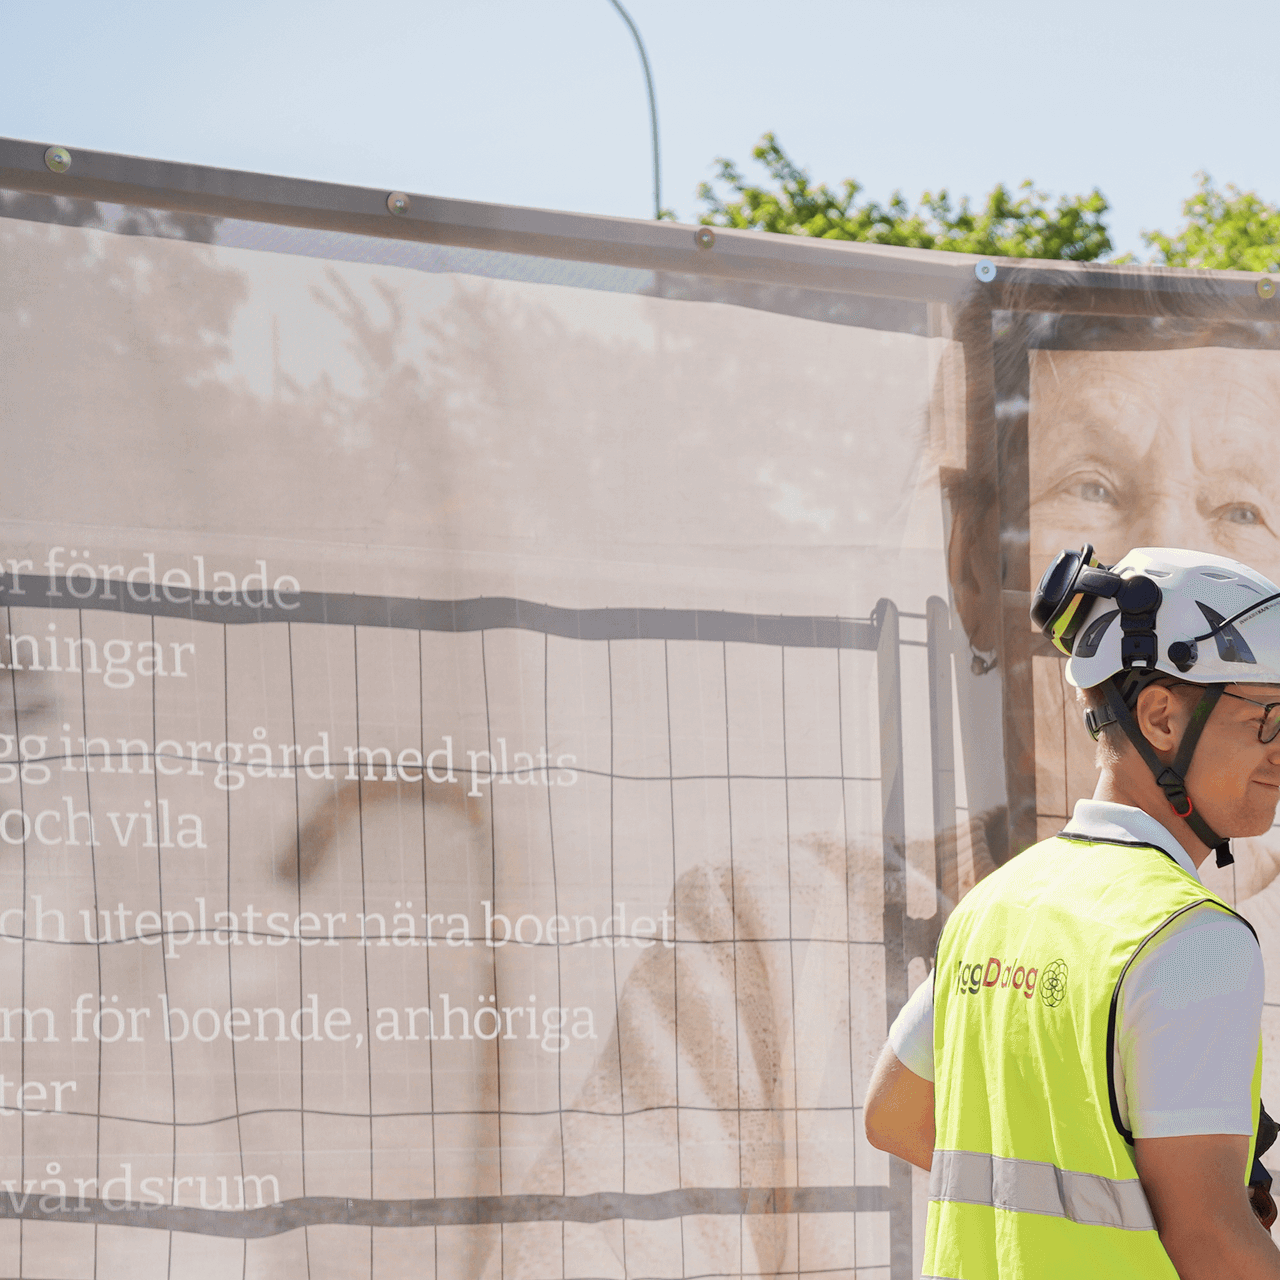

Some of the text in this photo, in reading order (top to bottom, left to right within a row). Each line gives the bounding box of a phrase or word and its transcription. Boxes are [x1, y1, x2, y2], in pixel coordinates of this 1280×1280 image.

[44, 547, 300, 610] fördelade
[0, 622, 195, 689] ningar
[60, 722, 334, 791] innergård
[344, 735, 457, 783] med
[466, 737, 578, 797] plats
[0, 796, 207, 849] och vila
[79, 897, 346, 959] uteplatser
[356, 901, 474, 947] nära
[480, 900, 676, 948] boendet
[71, 993, 150, 1043] för
[158, 993, 363, 1048] boende,
[375, 993, 598, 1053] anhöriga
[1, 1162, 284, 1214] vårdsrum
